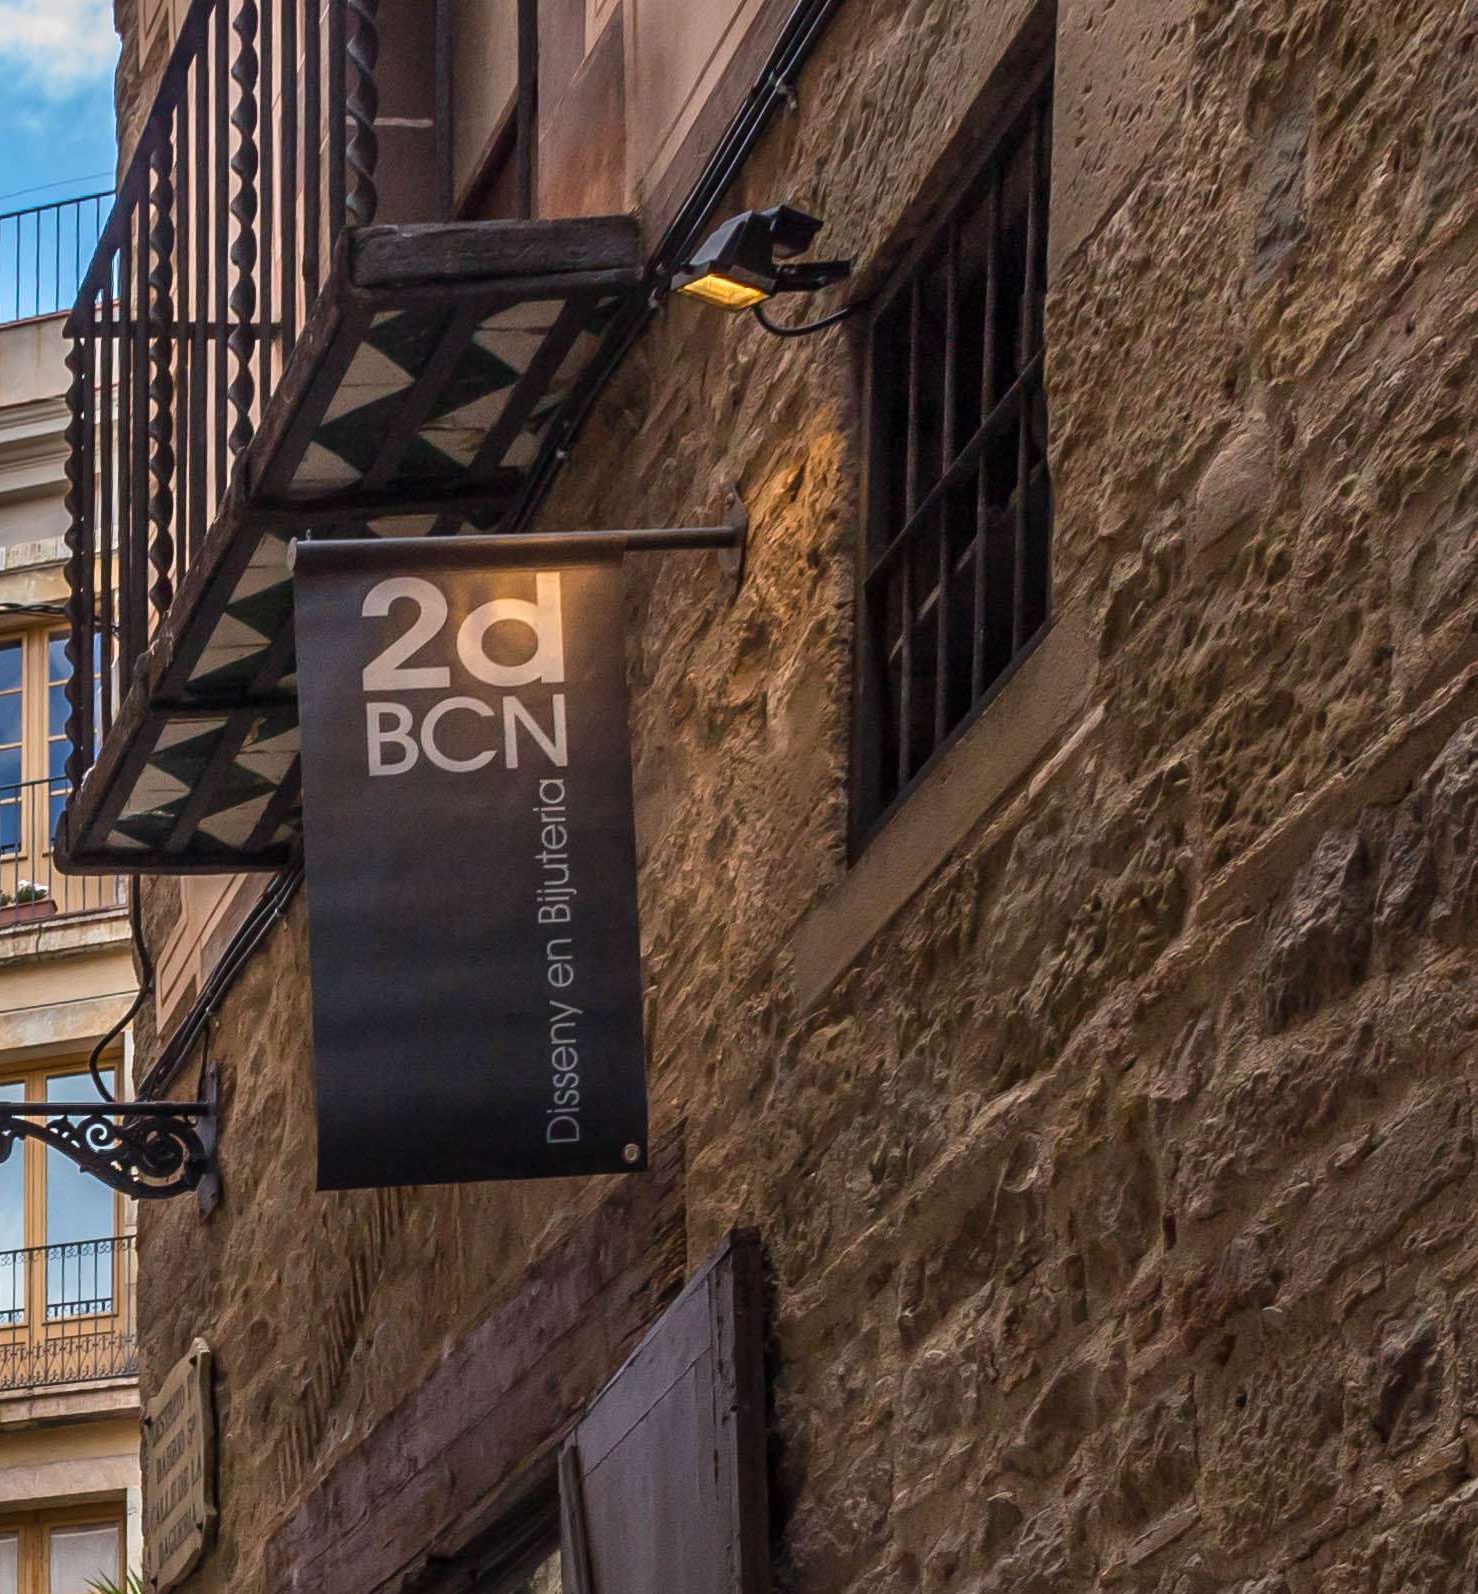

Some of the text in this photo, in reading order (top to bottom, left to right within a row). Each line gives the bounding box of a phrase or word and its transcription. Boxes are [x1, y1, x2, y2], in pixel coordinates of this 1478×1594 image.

[361, 571, 565, 691] 2d
[366, 693, 569, 777] BCN
[532, 778, 584, 1144] Disseny en Bijuteria
